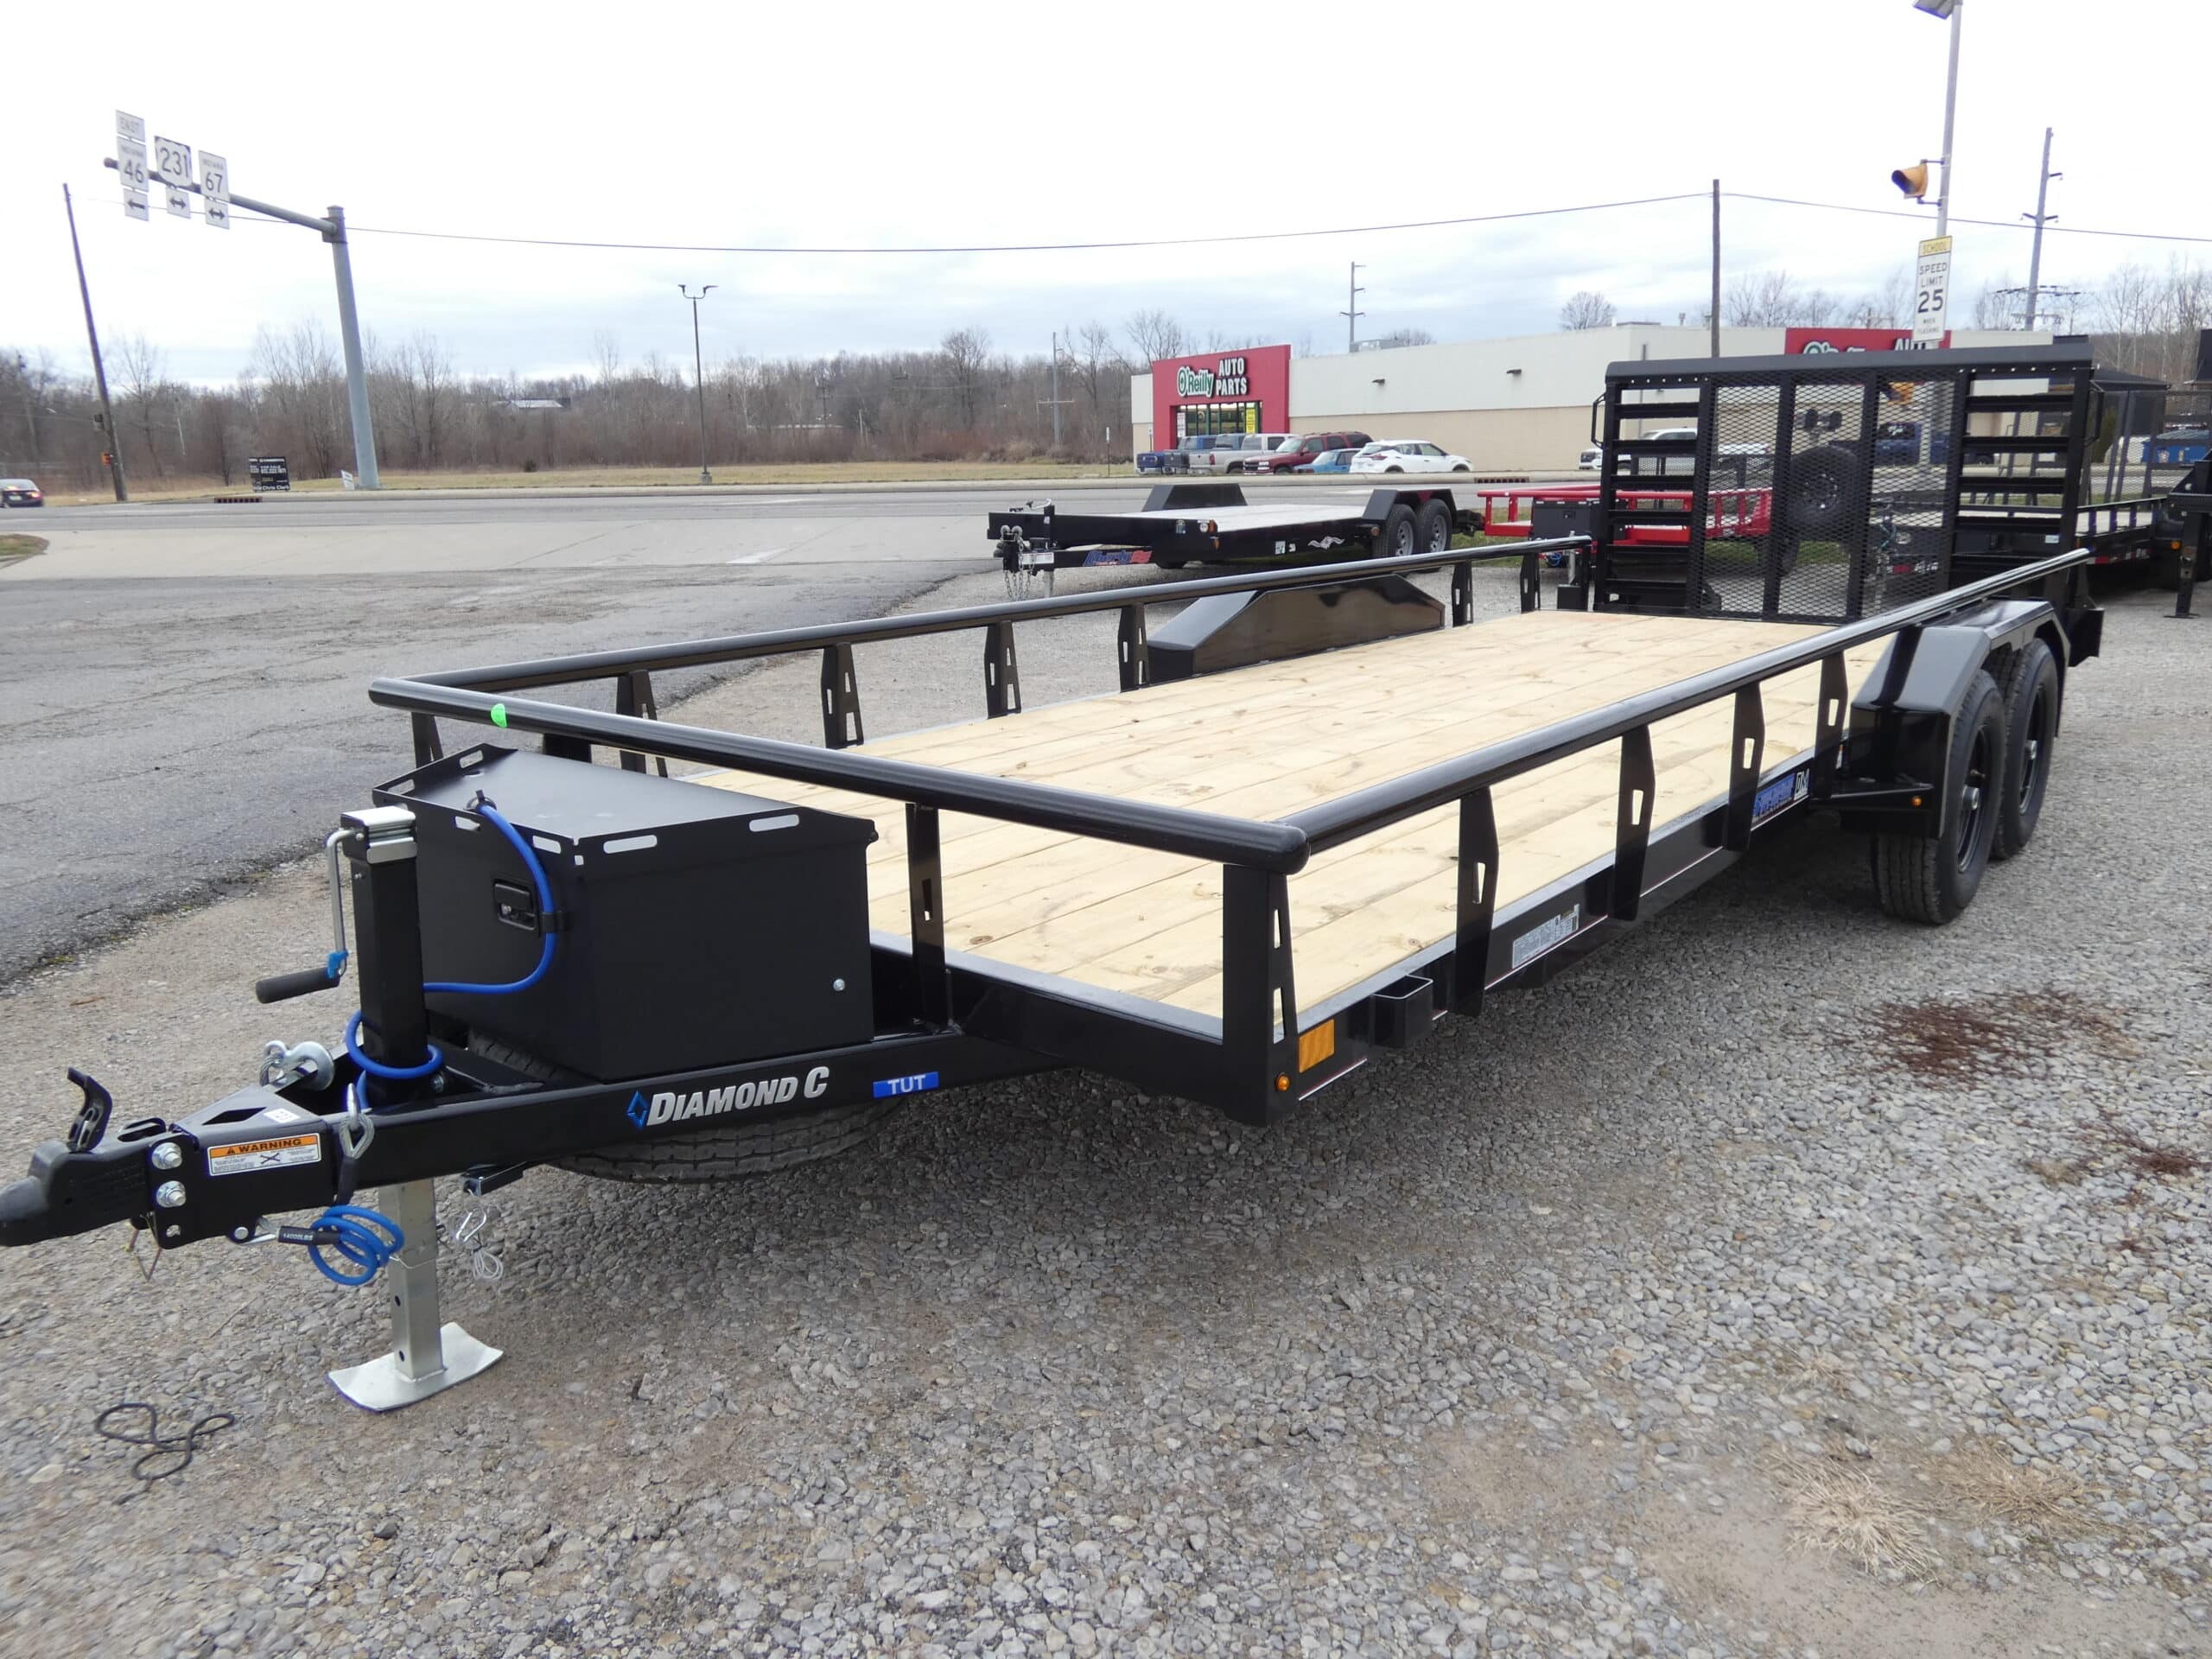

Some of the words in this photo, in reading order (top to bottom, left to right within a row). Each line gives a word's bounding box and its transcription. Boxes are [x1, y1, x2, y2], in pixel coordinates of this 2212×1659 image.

[124, 159, 144, 183] 46
[160, 147, 191, 180] 231
[206, 171, 223, 193] 67
[1923, 241, 1948, 255] SCHOOL
[1919, 262, 1948, 275] SPEED
[1921, 276, 1943, 288] LIMIT
[1917, 289, 1944, 314] 25
[1177, 365, 1216, 398] O'Reilly
[1218, 357, 1245, 377] AUTO
[1216, 377, 1248, 396] PARTS
[804, 1065, 830, 1099] C
[887, 1074, 926, 1096] TUT
[238, 1138, 302, 1153] WARNING
